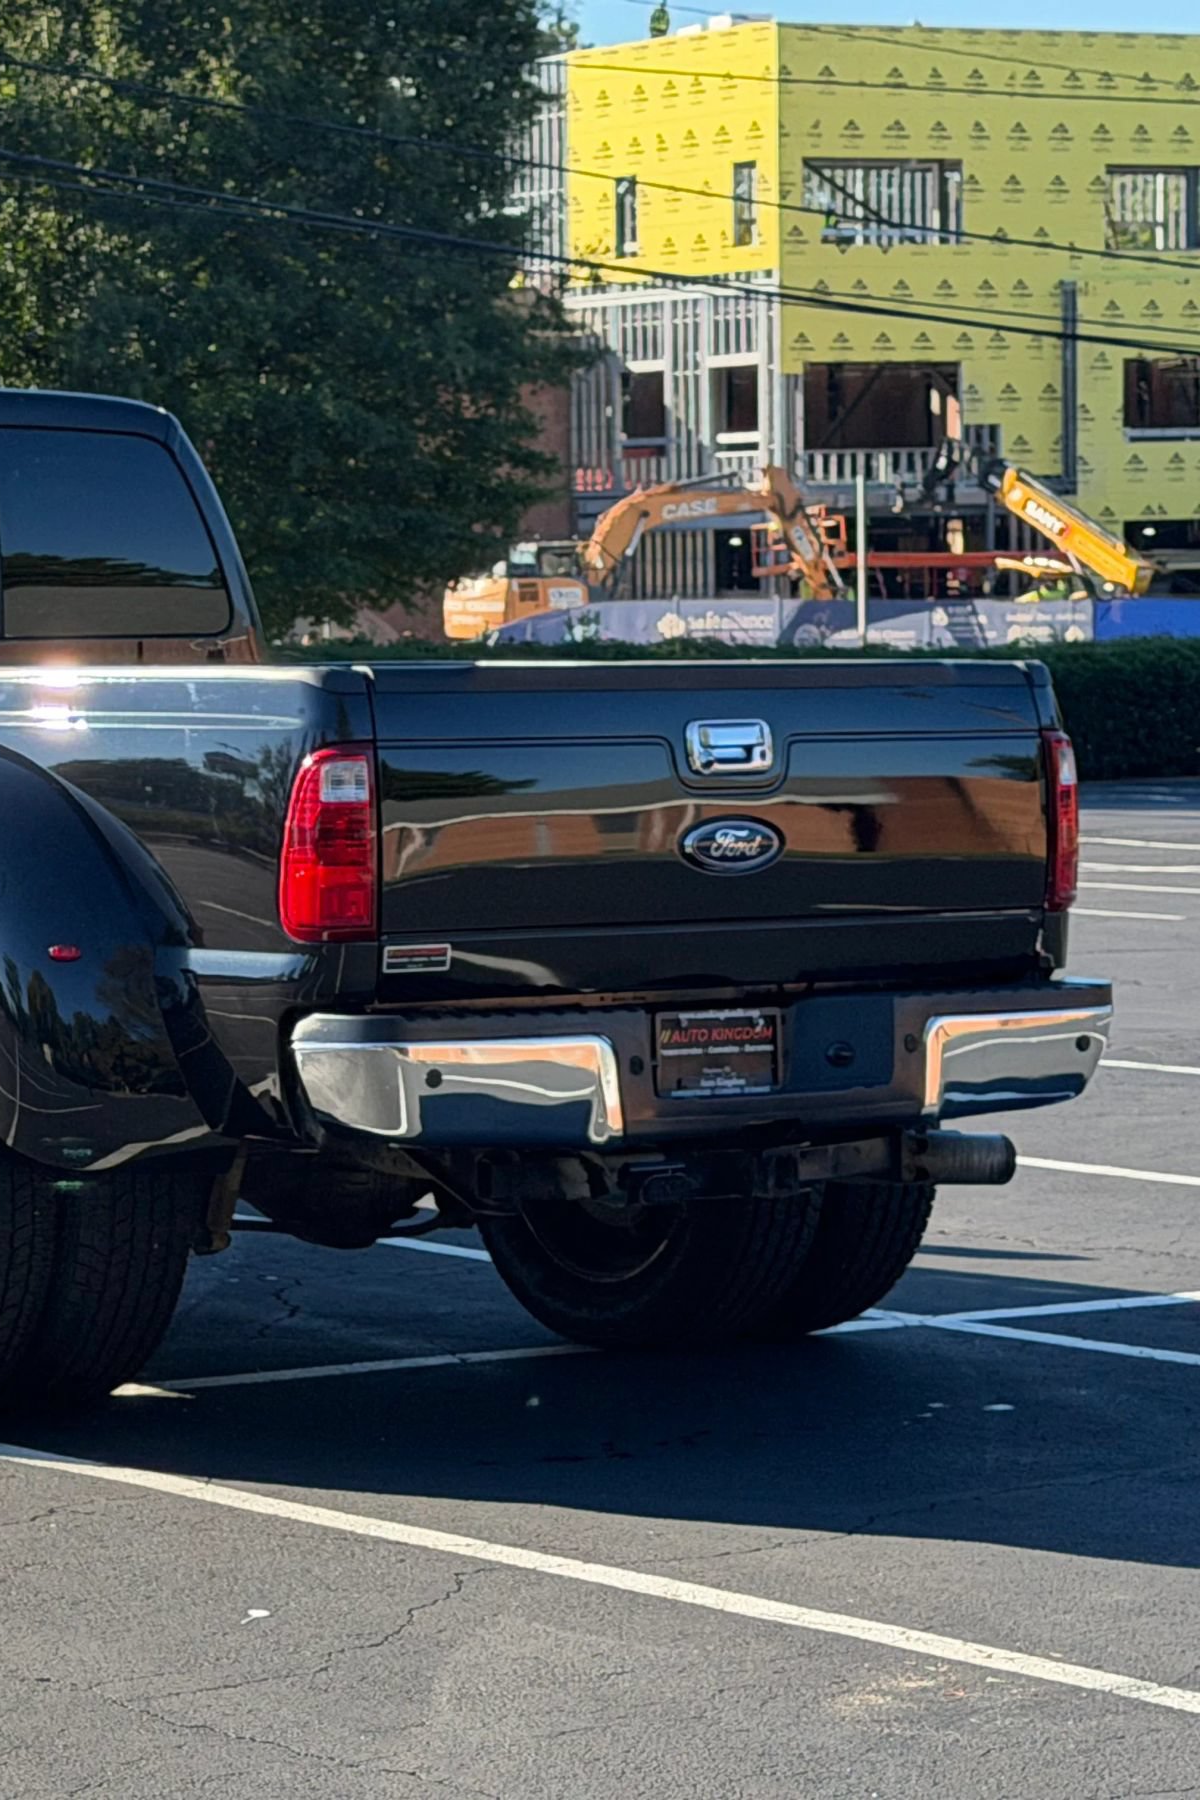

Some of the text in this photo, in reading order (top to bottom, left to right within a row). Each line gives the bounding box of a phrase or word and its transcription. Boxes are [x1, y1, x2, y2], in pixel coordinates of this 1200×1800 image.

[662, 498, 717, 519] CASE
[710, 829, 762, 857] Ford
[671, 1026, 773, 1043] AUTO KINGDOM
